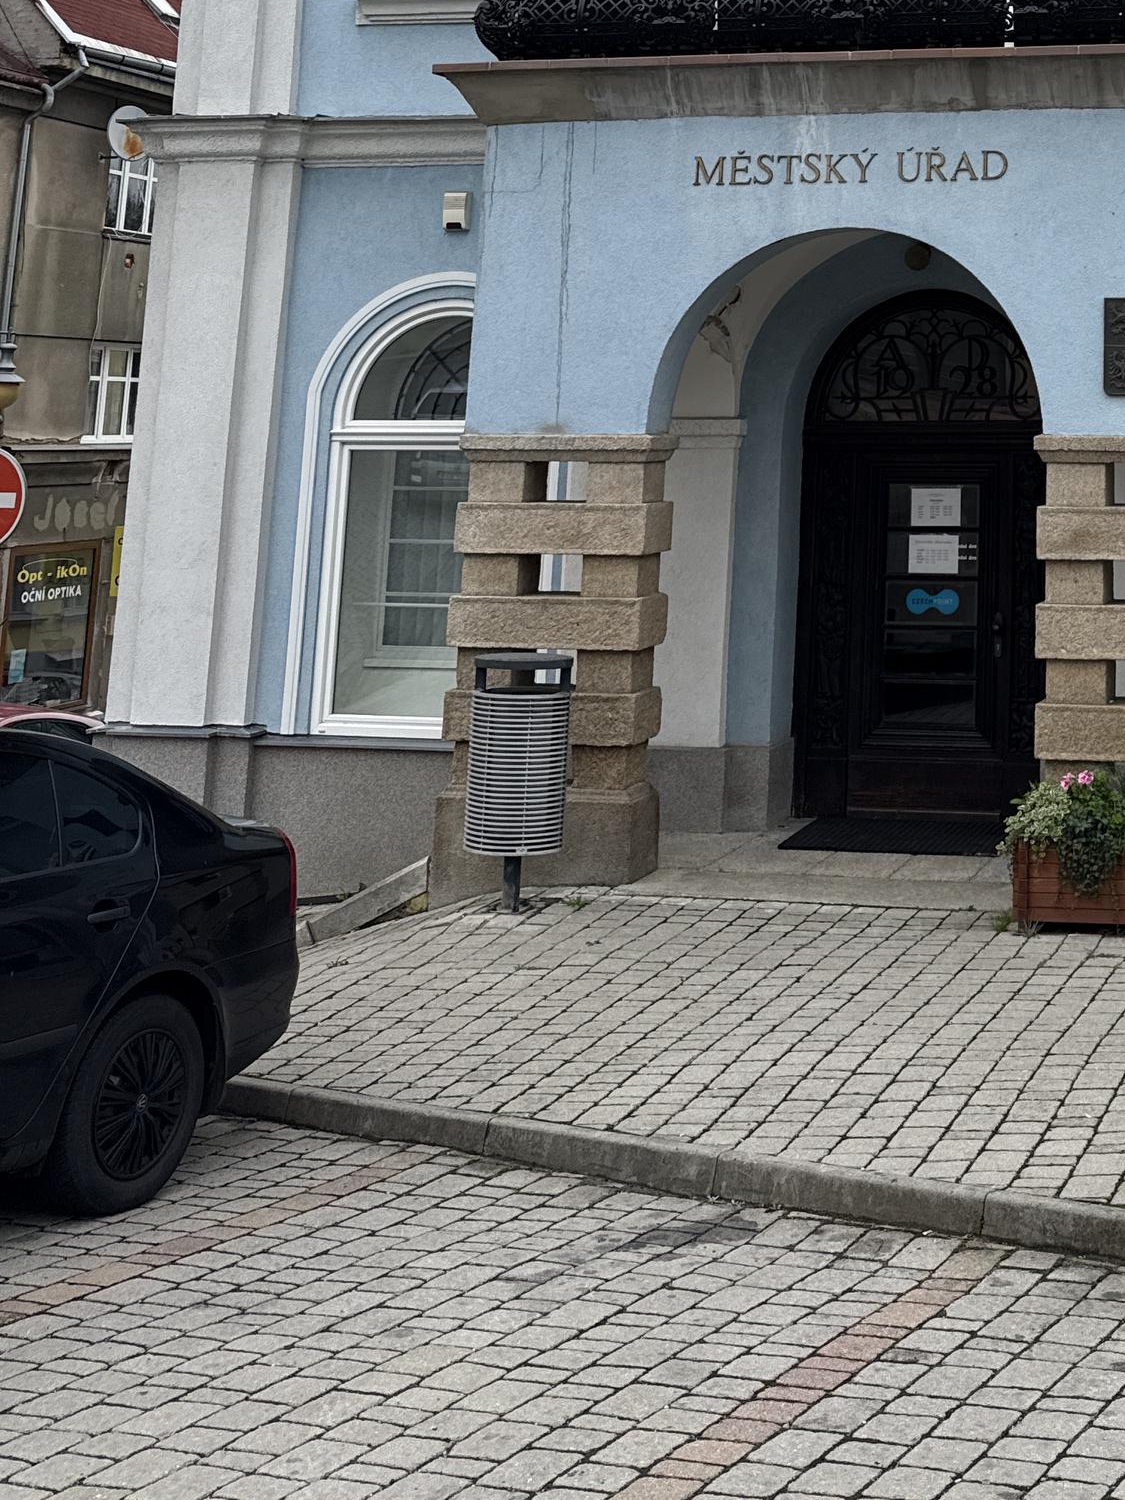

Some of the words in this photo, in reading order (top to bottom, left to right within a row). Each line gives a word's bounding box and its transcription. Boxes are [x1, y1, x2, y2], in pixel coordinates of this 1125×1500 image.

[692, 147, 879, 186] MĚSTSKÝ
[896, 146, 1010, 183] ÚŘAD
[21, 586, 46, 604] OČNÍ
[47, 585, 82, 600] OPTIKA
